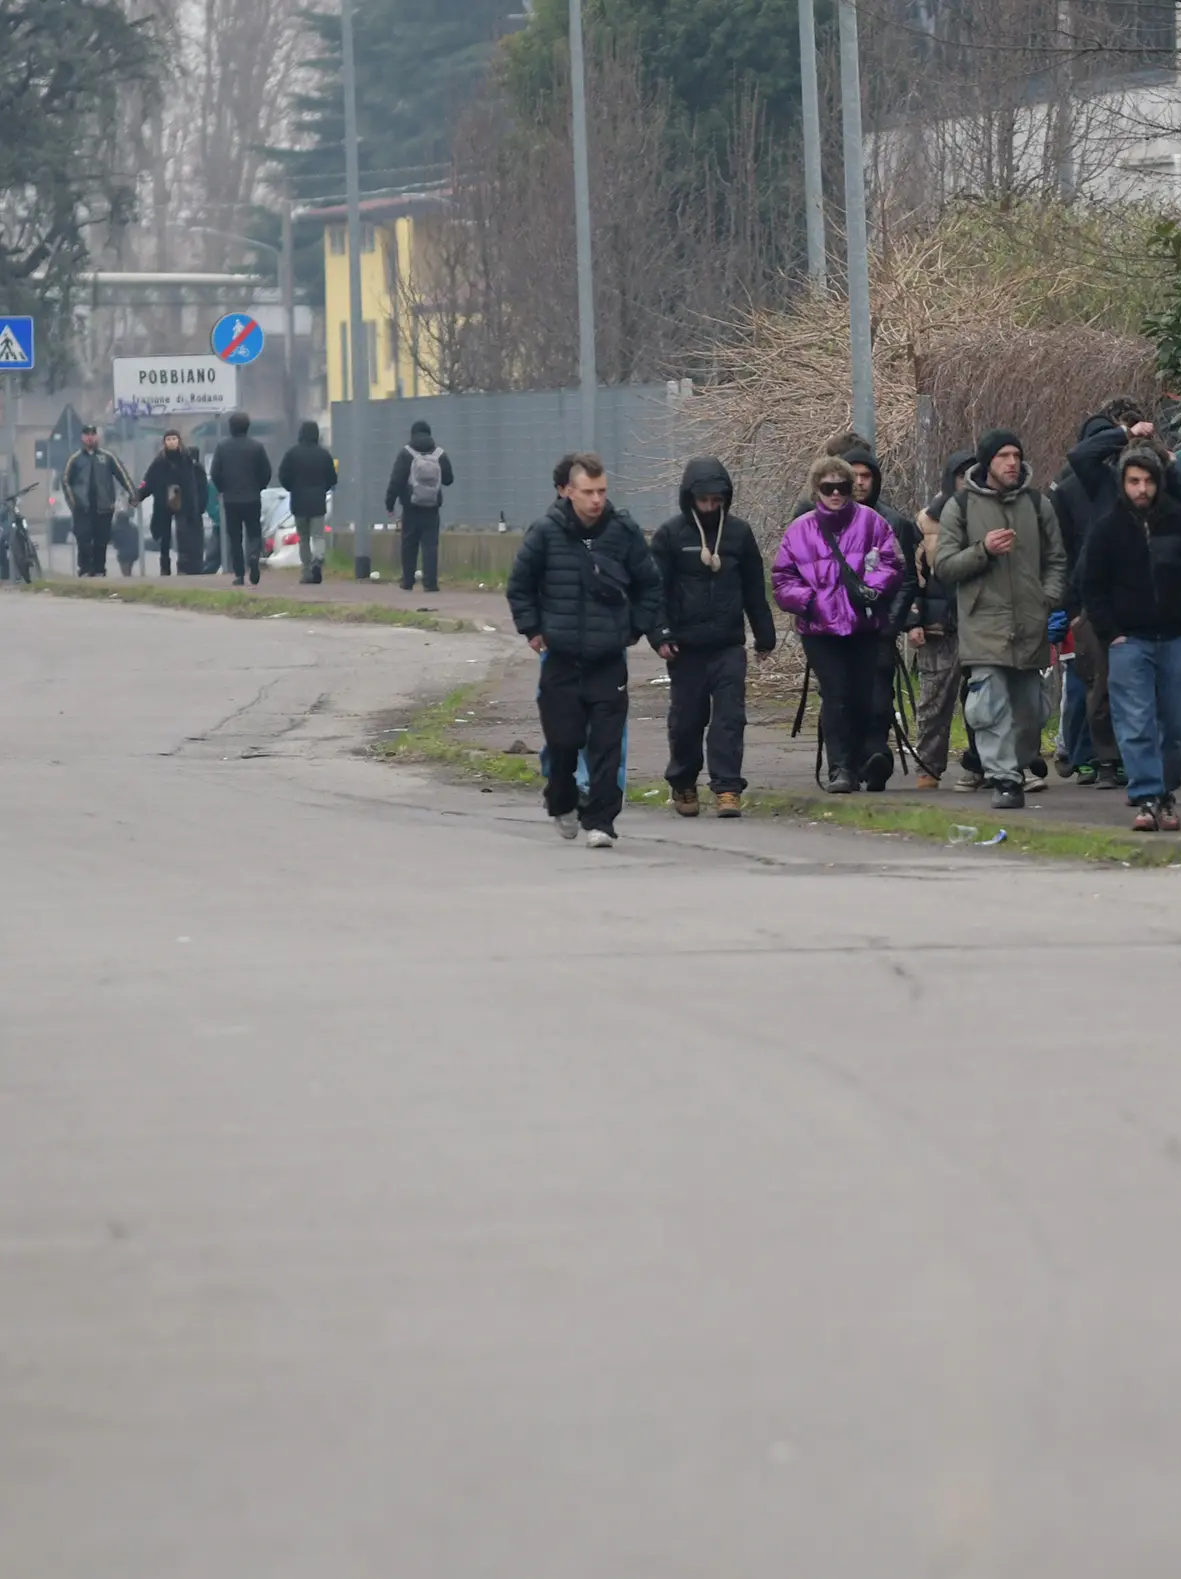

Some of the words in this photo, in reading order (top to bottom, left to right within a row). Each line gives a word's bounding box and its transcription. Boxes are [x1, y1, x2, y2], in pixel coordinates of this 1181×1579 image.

[139, 368, 216, 384] POBBIANO
[176, 393, 184, 403] di
[190, 392, 224, 402] Rodano
